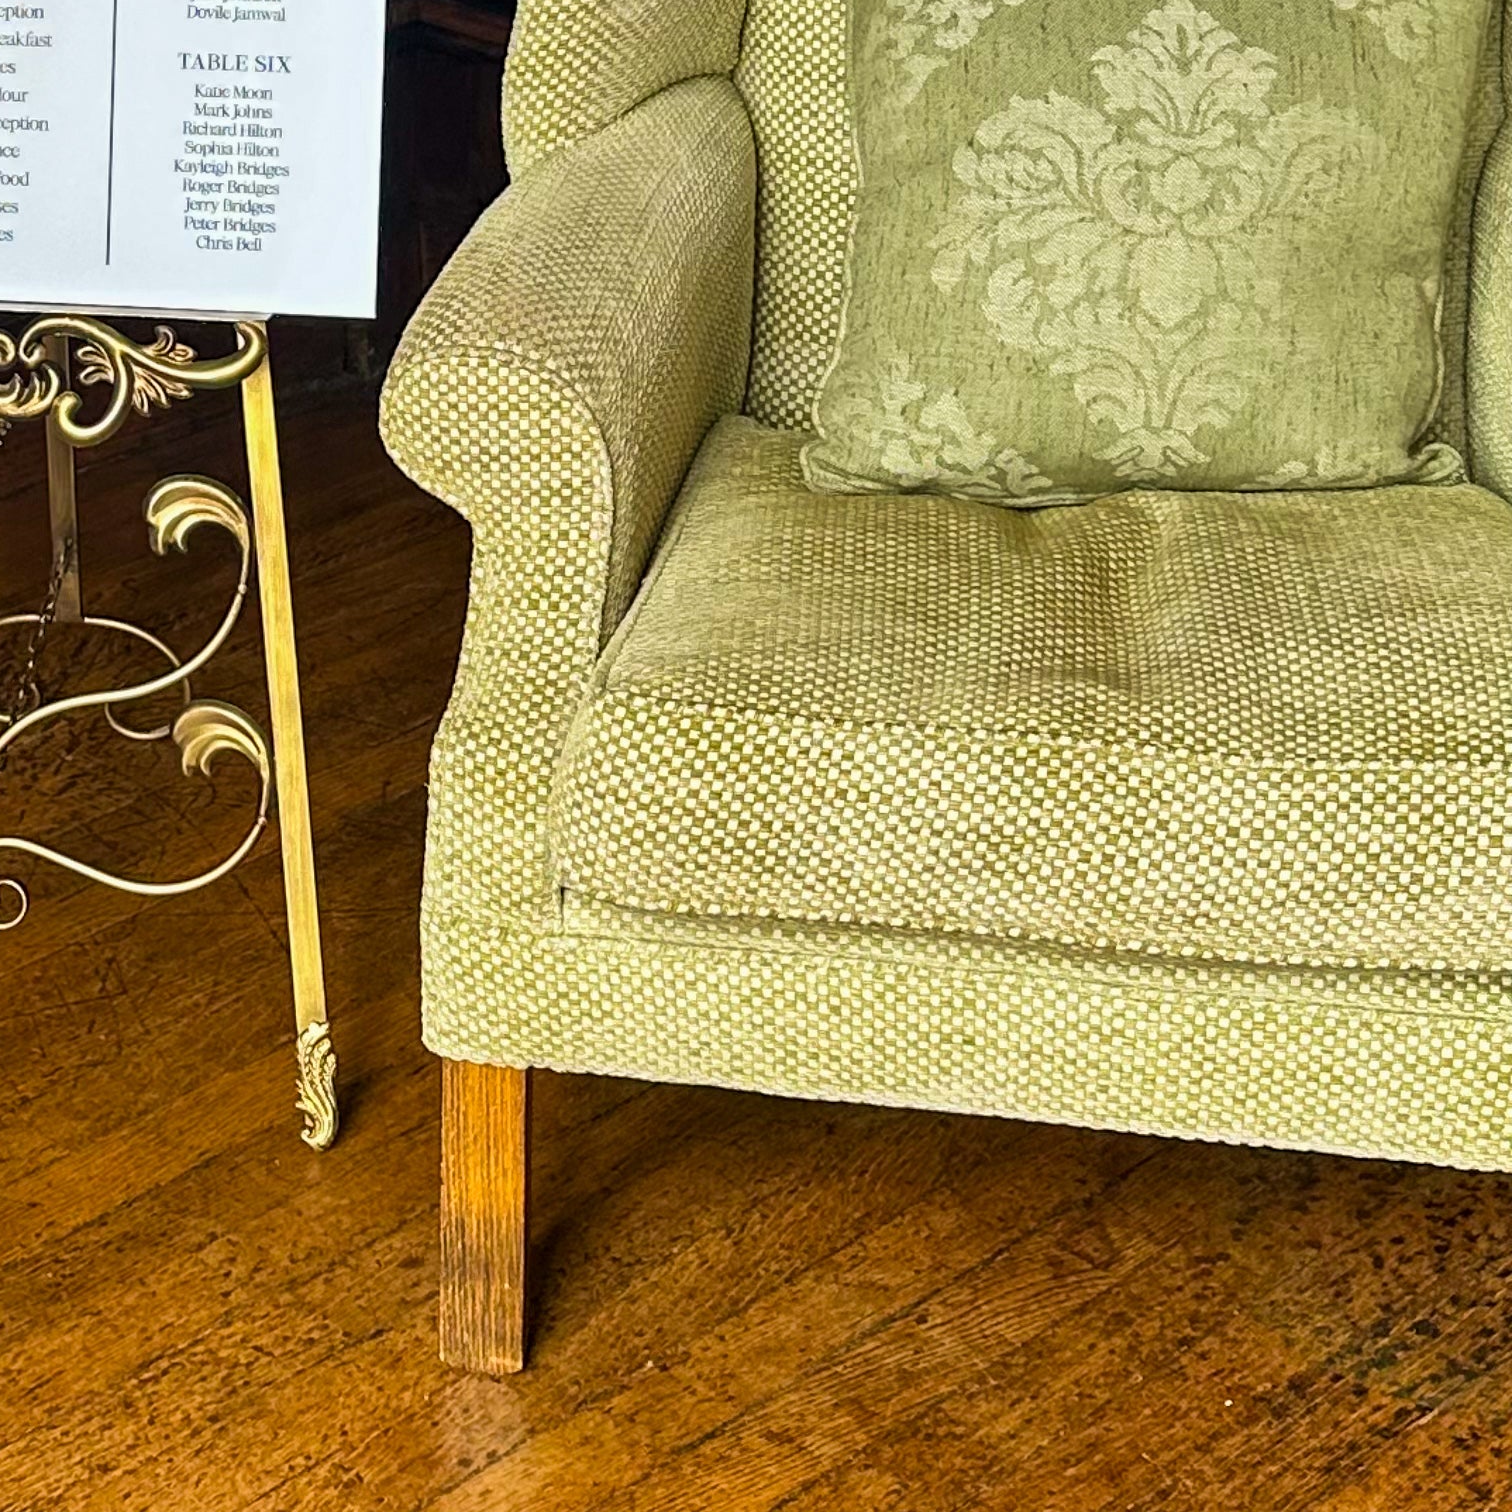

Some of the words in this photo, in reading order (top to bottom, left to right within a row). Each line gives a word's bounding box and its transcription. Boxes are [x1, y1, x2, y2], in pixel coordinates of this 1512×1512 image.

[177, 52, 248, 72] TABLE
[255, 55, 291, 74] SIX
[194, 84, 230, 98] Katie
[233, 85, 272, 100] Moon
[194, 103, 230, 117] Mark
[231, 104, 272, 120] Johns
[183, 121, 237, 137] Richard
[240, 124, 282, 138] Hilton
[236, 142, 279, 157] Hilton
[238, 161, 290, 179] Bridges
[183, 177, 224, 196] Roger
[227, 180, 280, 197] Bridges
[184, 197, 220, 214] Jerry
[223, 198, 275, 215] Bridges
[184, 215, 221, 231] Peter
[224, 218, 276, 234] Bridges
[196, 235, 233, 250] Chris
[236, 237, 262, 251] Bell
